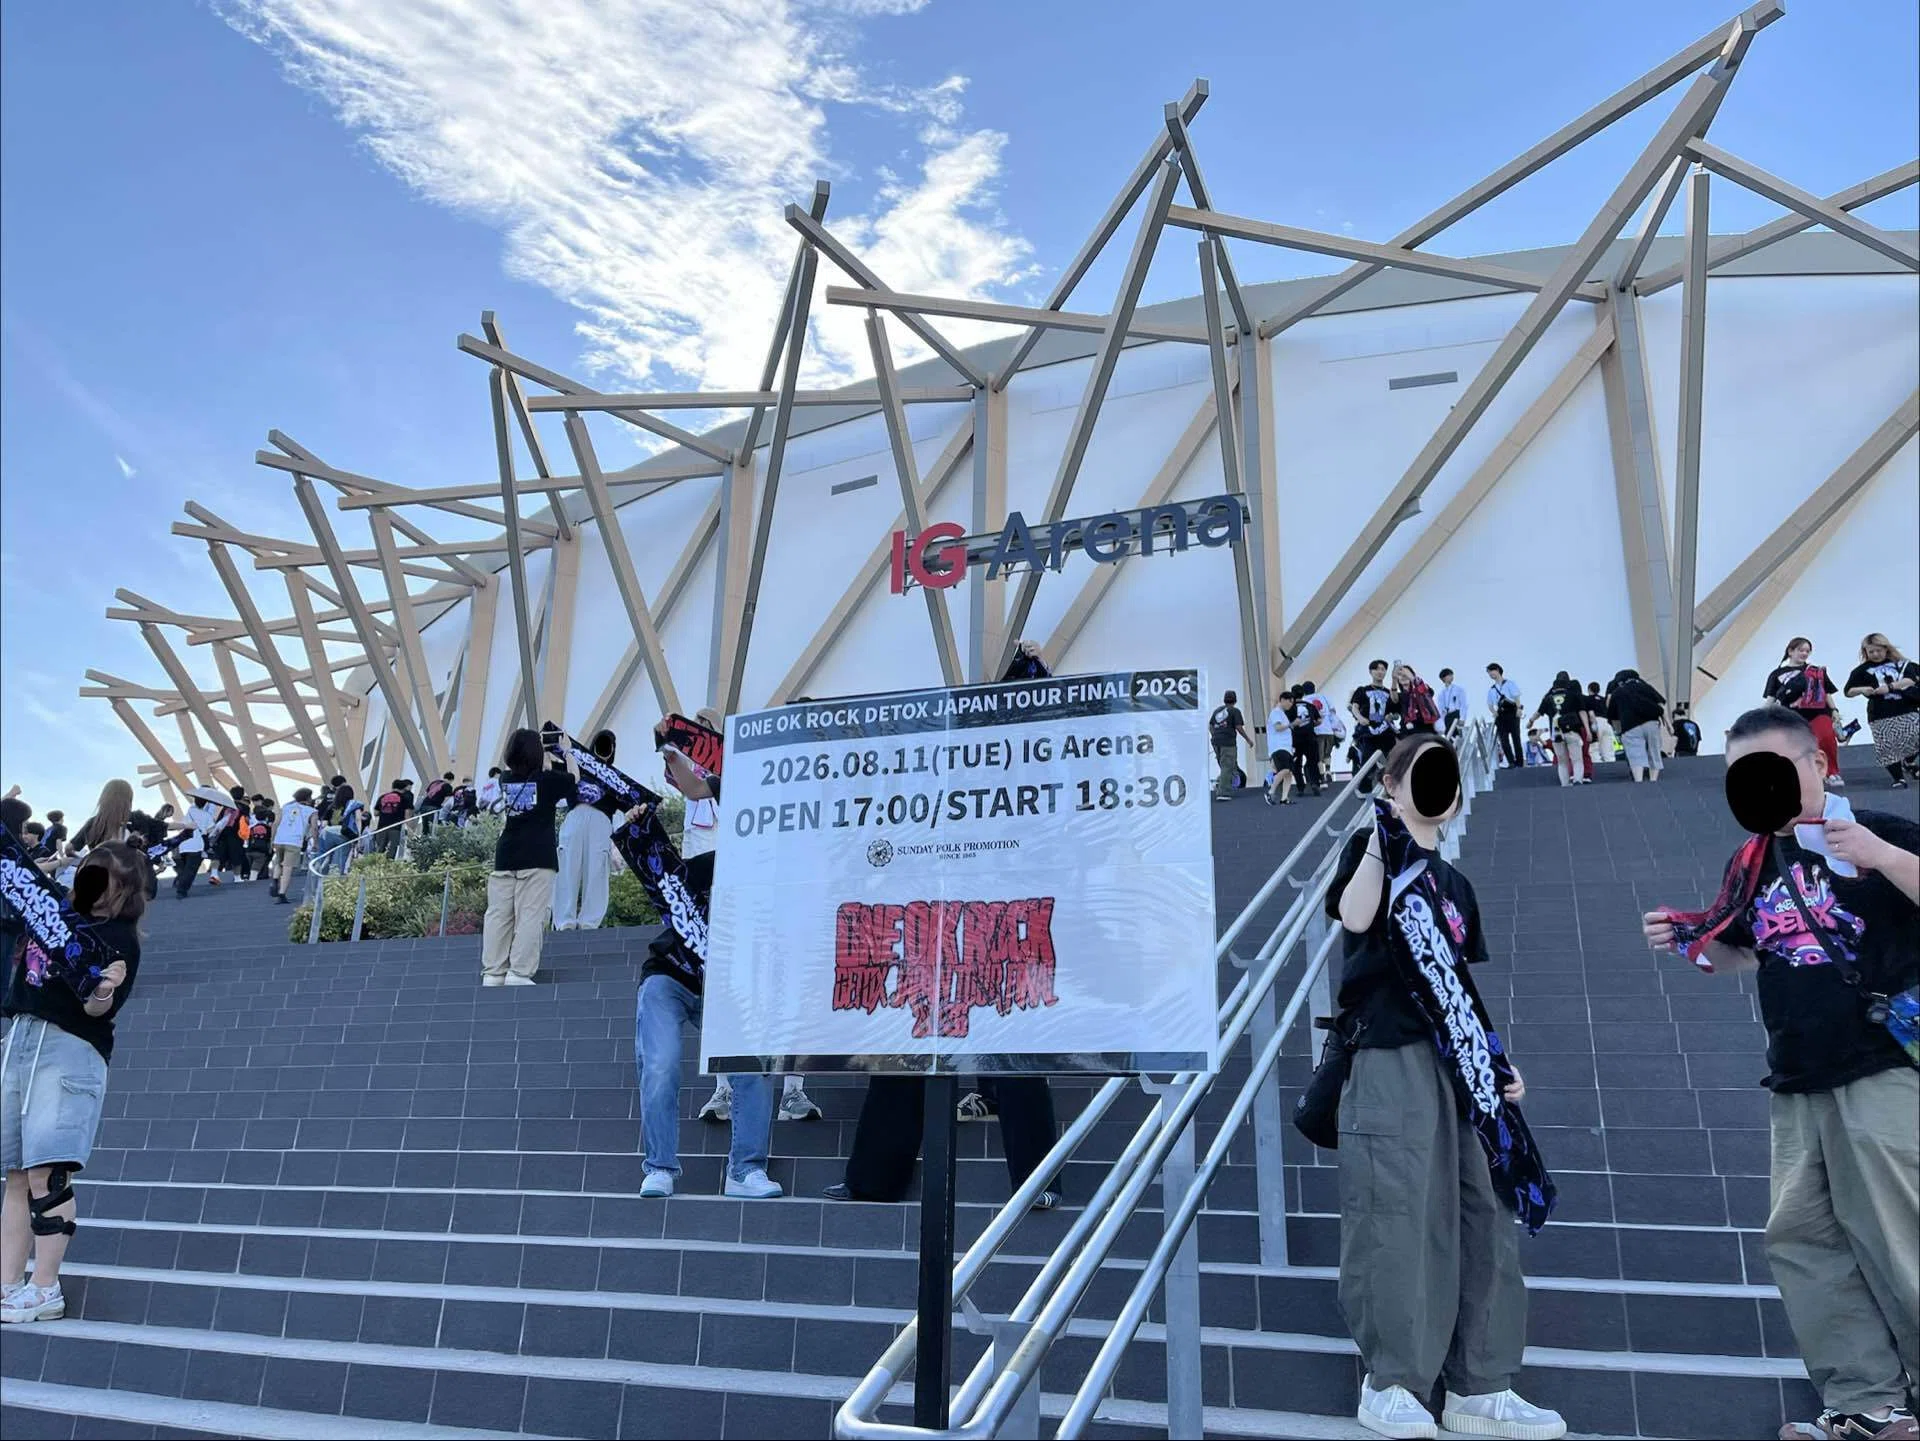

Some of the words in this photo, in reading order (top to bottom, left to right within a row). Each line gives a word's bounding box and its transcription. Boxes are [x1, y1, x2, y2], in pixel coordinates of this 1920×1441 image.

[890, 522, 968, 594] IG
[986, 494, 1243, 581] Arena
[738, 717, 773, 739] ONE
[776, 713, 802, 732] OK
[806, 708, 860, 729] ROCK
[864, 700, 929, 724] DETOX
[932, 693, 998, 718] JAPAN
[1003, 686, 1062, 709] TOUR
[1067, 680, 1130, 703] FINAL
[1135, 677, 1192, 697] 2026
[760, 738, 1012, 786] 2026.08.11(TUE)
[1023, 737, 1052, 763] IG
[1060, 733, 1155, 761] Arena
[735, 800, 821, 838] OPEN
[832, 781, 1064, 829] 17:00/START
[1075, 774, 1187, 812] 18:30
[897, 844, 934, 856] SUNDAY
[936, 843, 961, 853] FOLK
[963, 839, 1020, 852] PROMOTION
